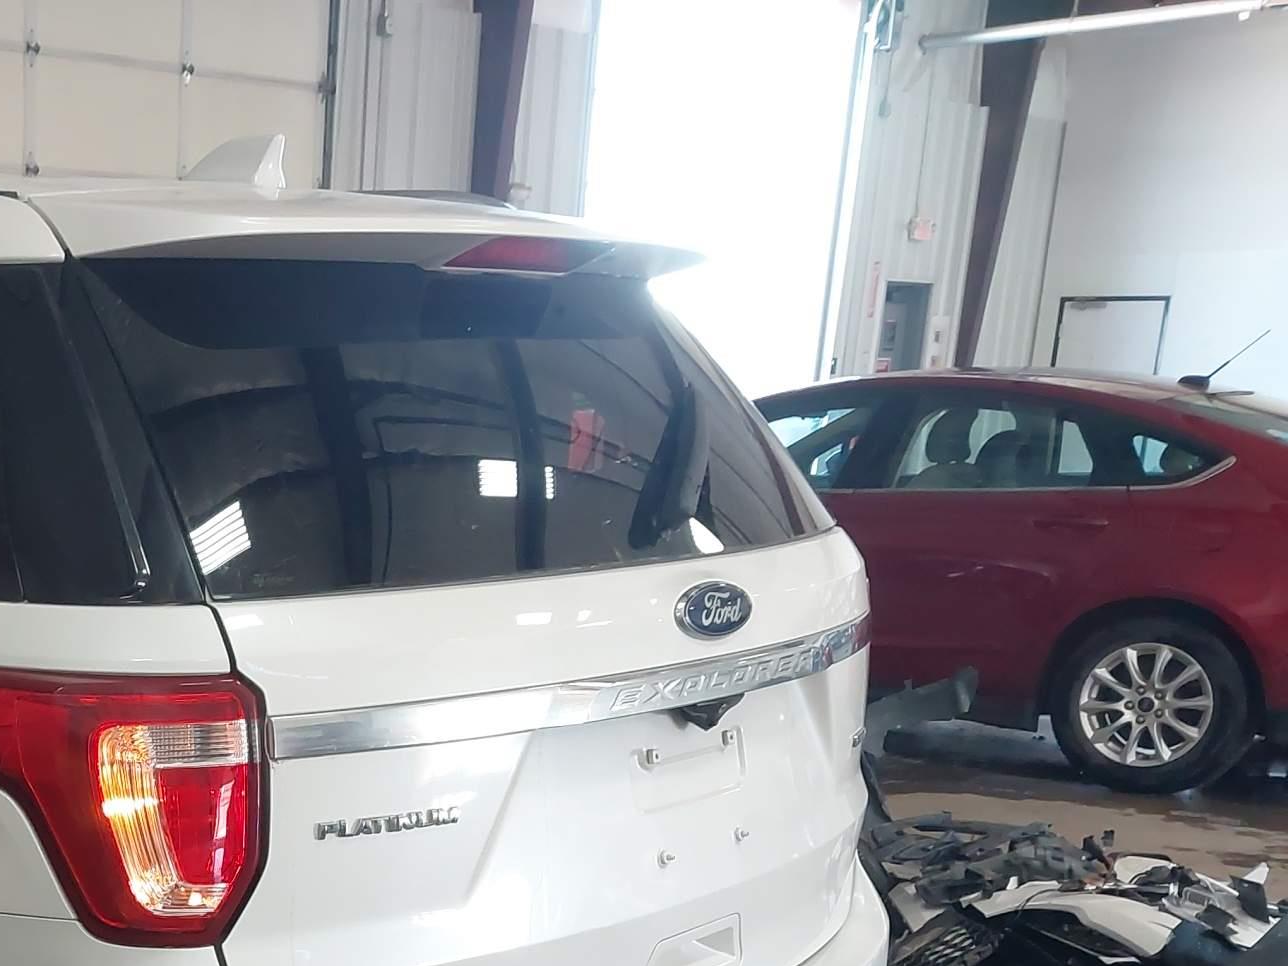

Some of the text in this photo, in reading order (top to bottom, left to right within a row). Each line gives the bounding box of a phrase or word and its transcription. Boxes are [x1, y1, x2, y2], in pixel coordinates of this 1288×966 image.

[701, 591, 742, 626] Ford
[609, 646, 822, 711] EXPLORER
[312, 805, 460, 840] PLATINUM
